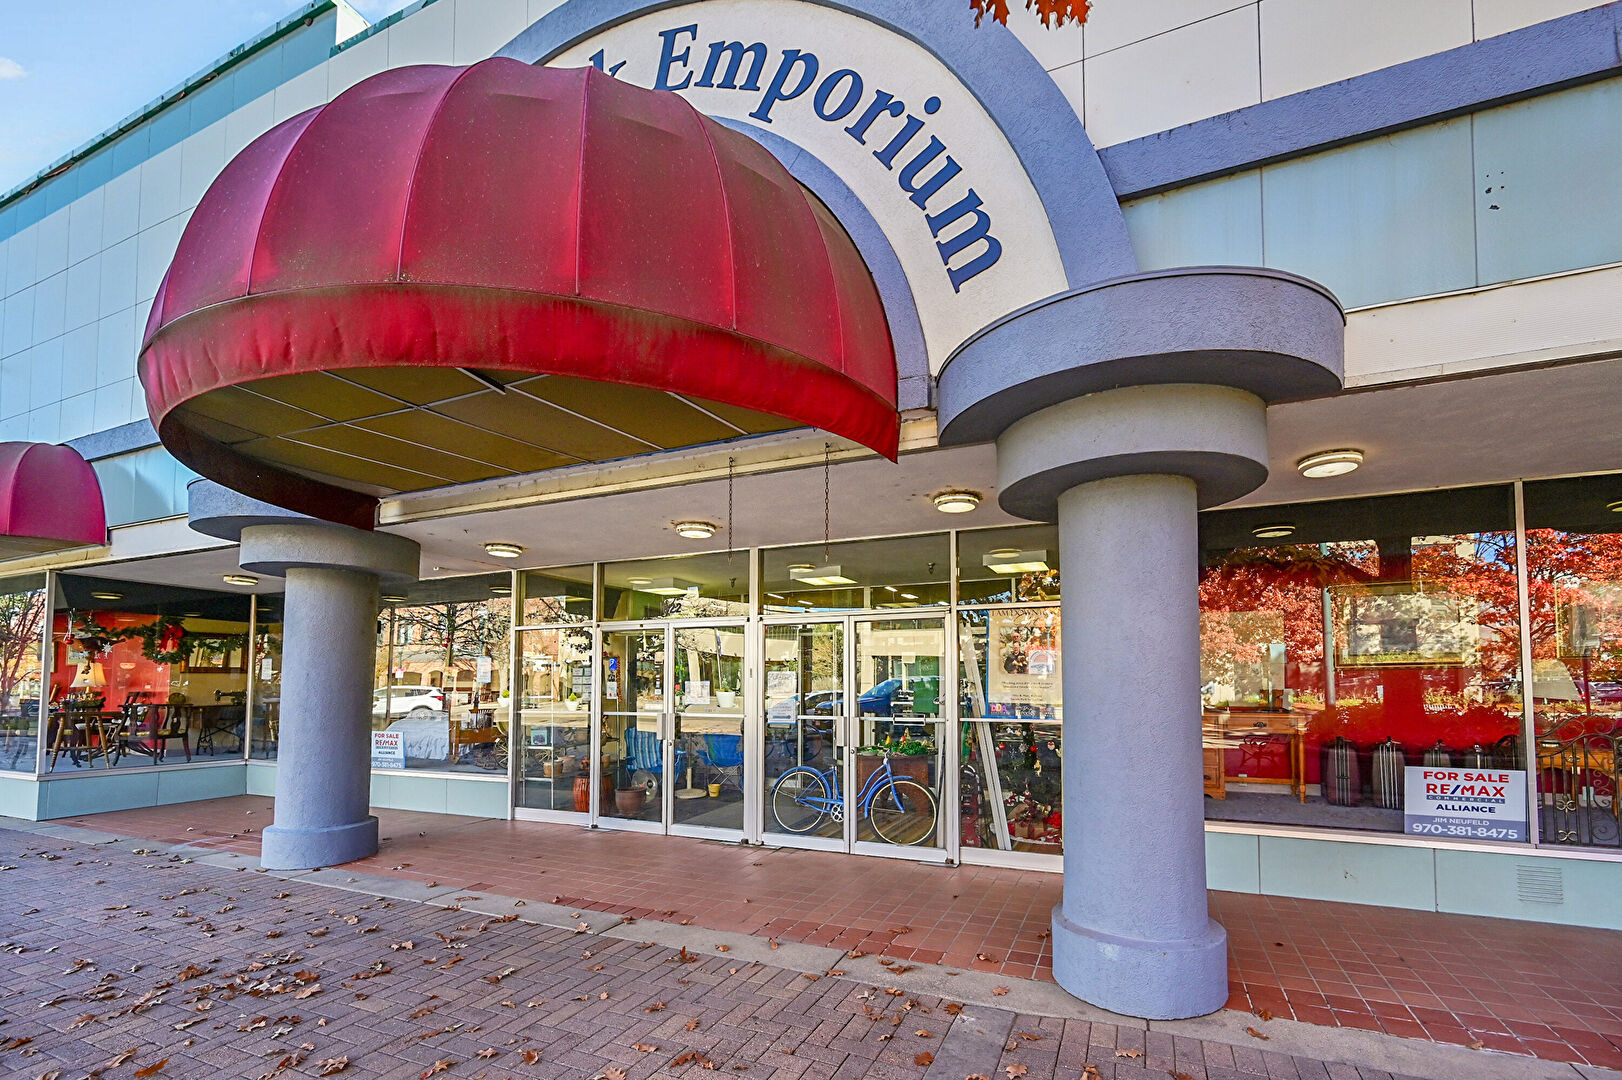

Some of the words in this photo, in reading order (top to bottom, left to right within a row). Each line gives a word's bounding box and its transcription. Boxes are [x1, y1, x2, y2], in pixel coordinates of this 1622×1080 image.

[653, 23, 1003, 294] Emporium
[1423, 771, 1459, 781] FOR
[1463, 772, 1510, 783] SALE
[1426, 783, 1505, 797] RE/MAX
[1428, 795, 1503, 804] COMMERCIAL
[1436, 804, 1496, 813] ALLIANCE
[1448, 818, 1490, 826] NEUFELD
[1412, 823, 1518, 839] 970-381-8475
